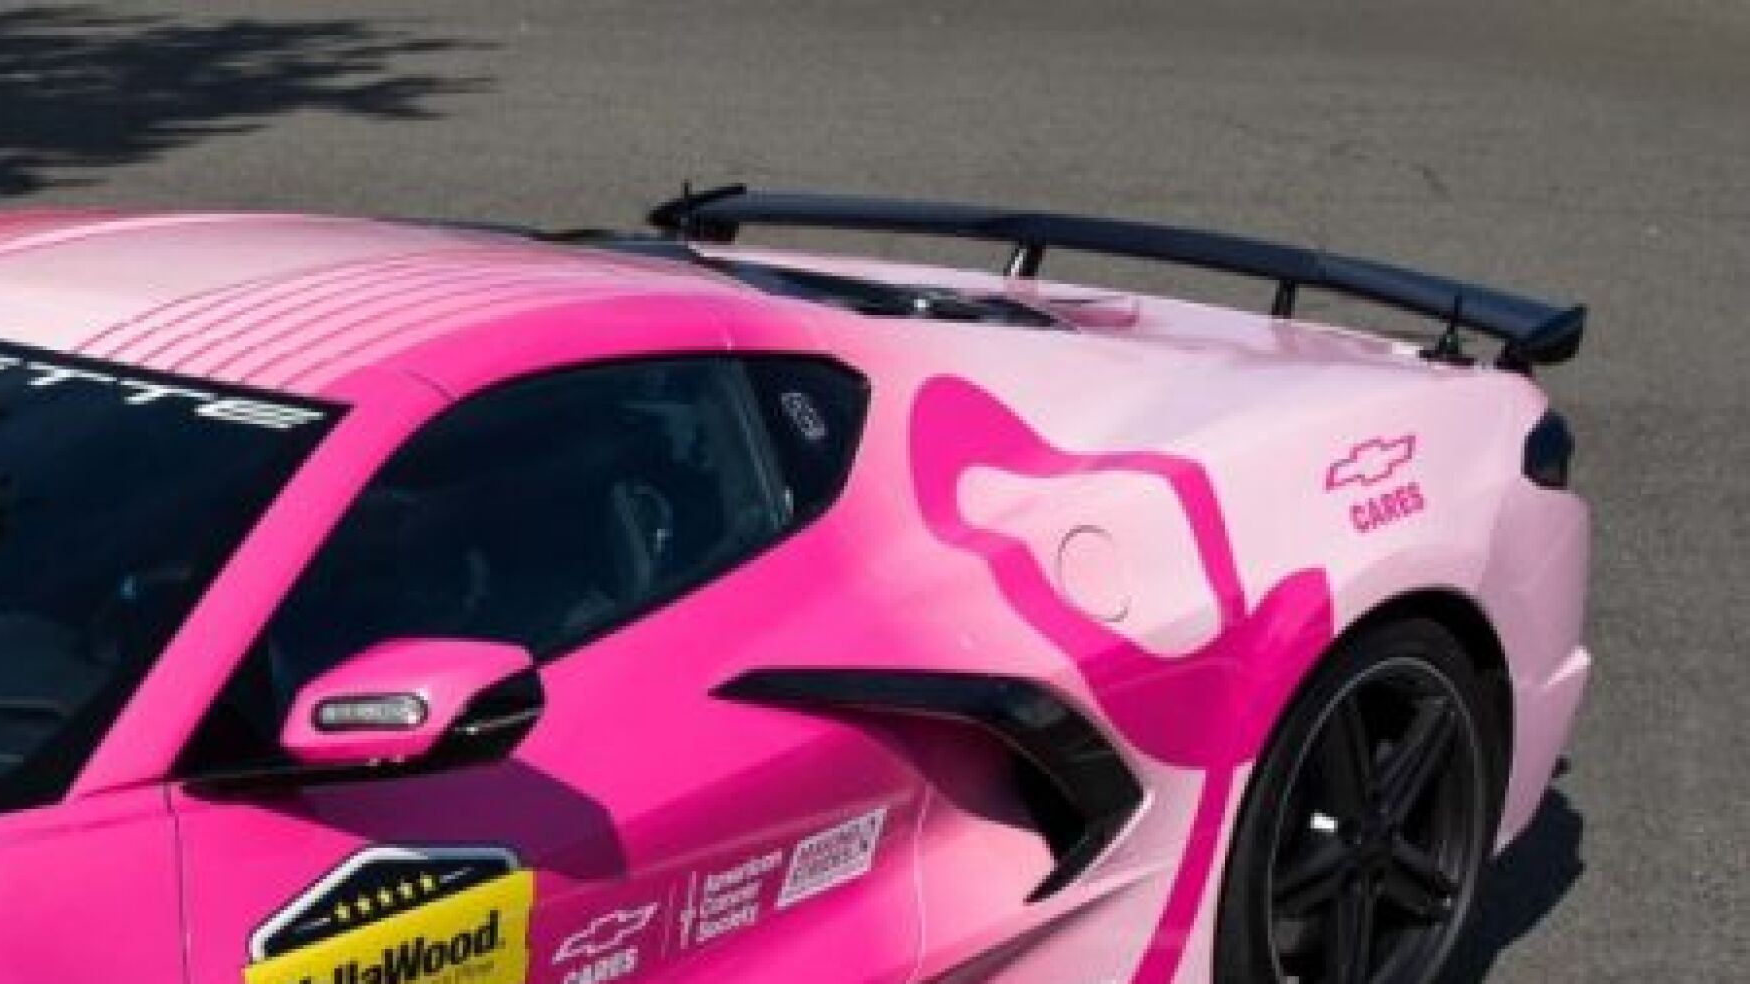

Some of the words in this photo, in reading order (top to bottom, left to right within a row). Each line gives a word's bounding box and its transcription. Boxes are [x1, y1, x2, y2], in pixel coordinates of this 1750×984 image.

[1349, 482, 1425, 534] CARES
[703, 848, 783, 895] American
[700, 879, 763, 918] Cancer
[696, 902, 762, 942] Society
